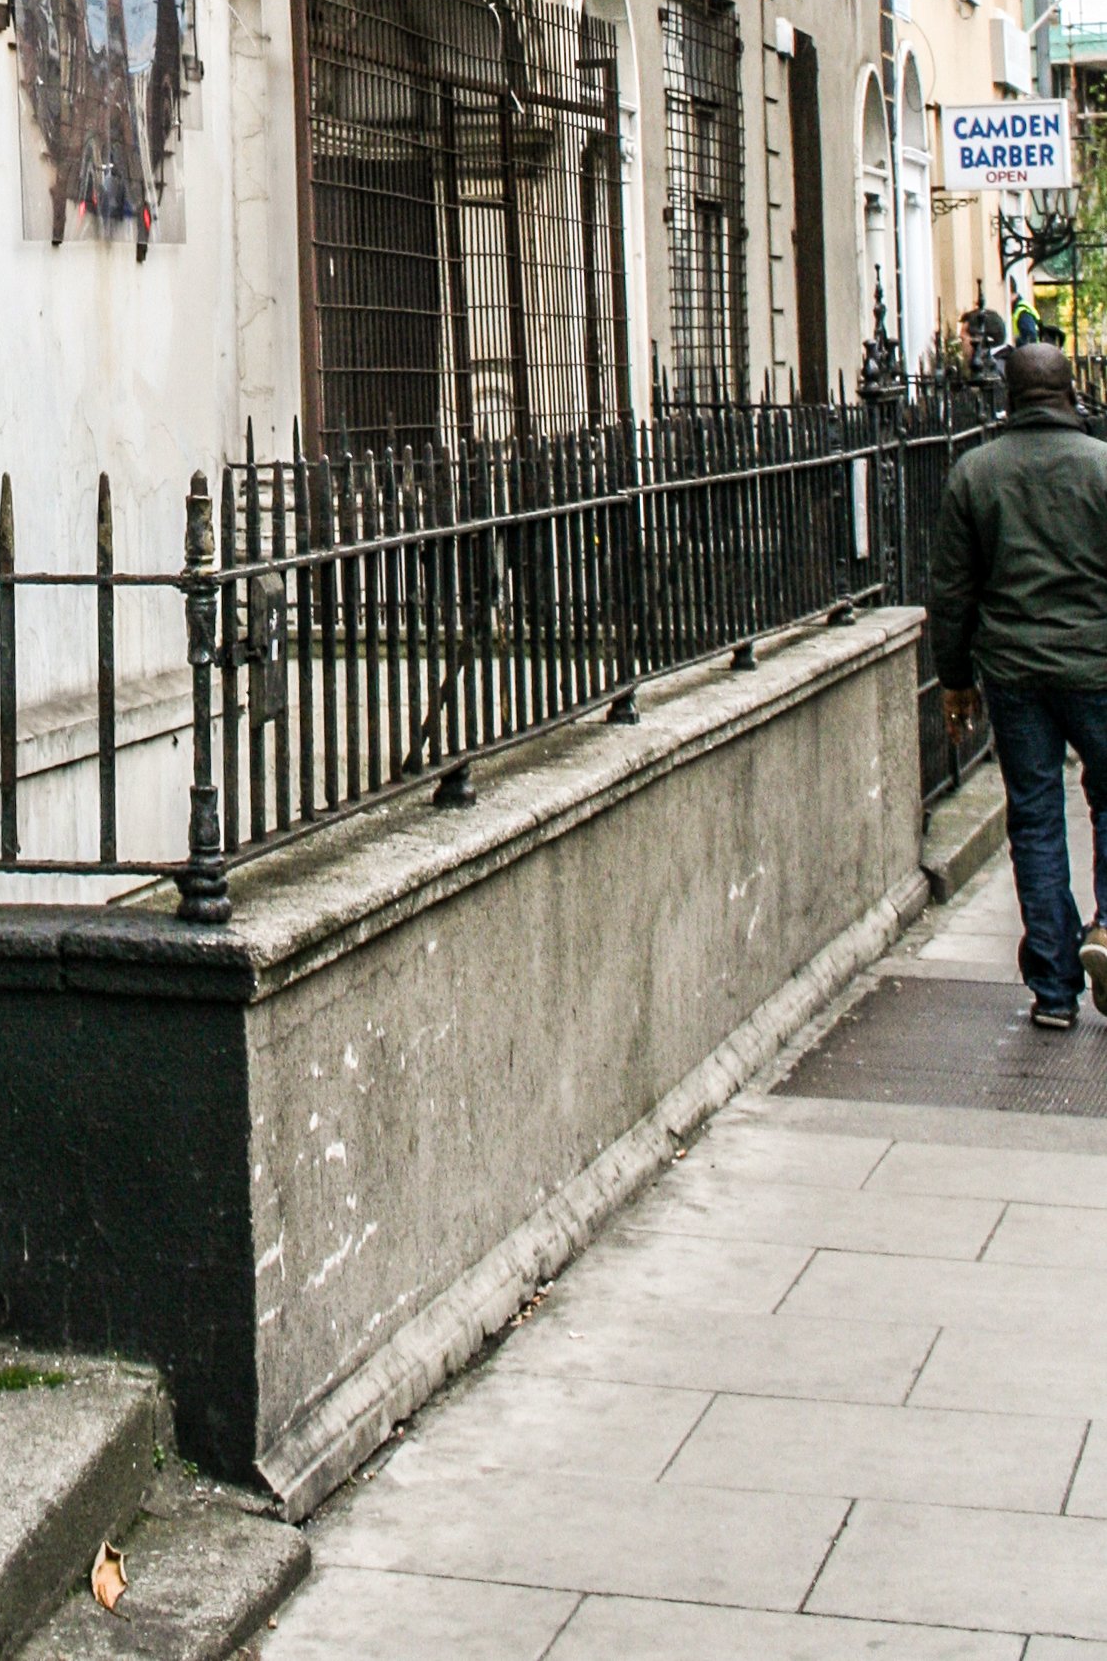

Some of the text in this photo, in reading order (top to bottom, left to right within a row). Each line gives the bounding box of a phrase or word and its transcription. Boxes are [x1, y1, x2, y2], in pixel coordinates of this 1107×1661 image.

[954, 114, 1059, 140] CAMDEN
[960, 144, 1054, 169] BARBER
[986, 171, 1028, 183] OPEN
